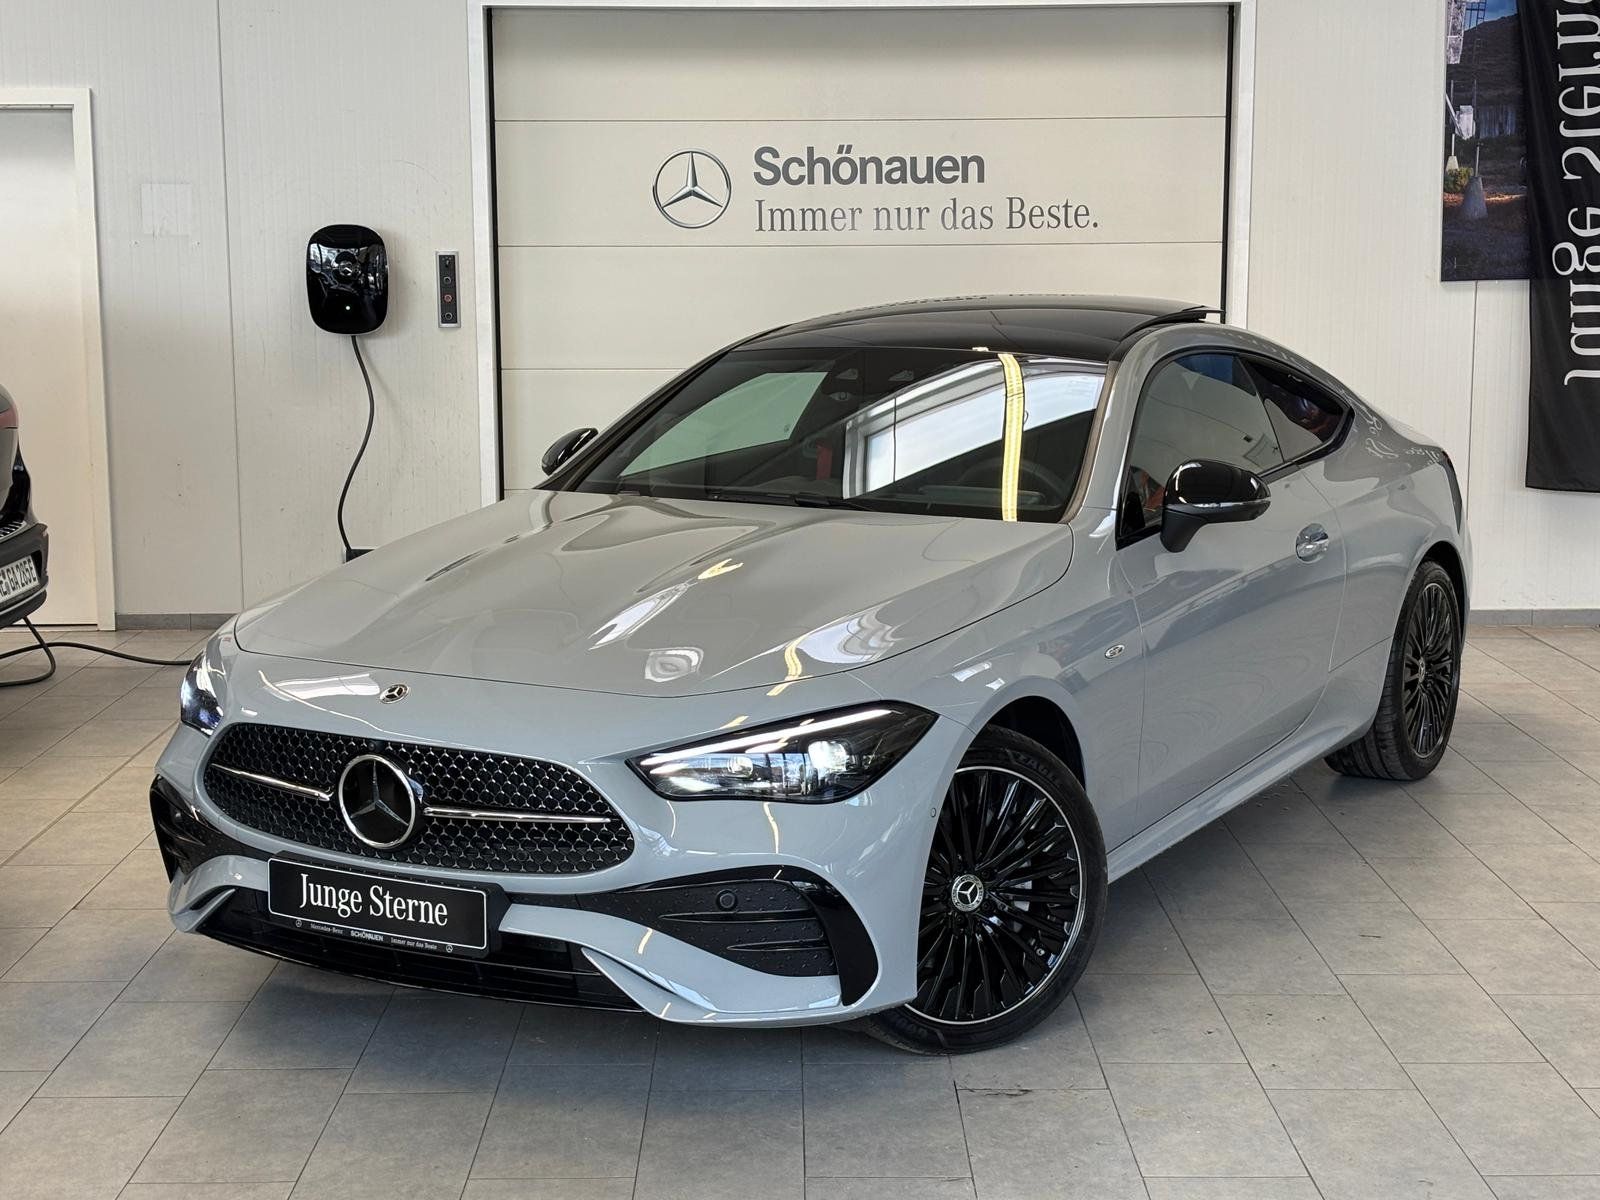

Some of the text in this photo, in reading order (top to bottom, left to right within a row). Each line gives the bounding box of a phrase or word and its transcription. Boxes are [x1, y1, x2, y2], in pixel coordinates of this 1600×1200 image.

[753, 144, 985, 186] Schönauen
[754, 196, 1099, 232] Immer nur das Beste.
[299, 873, 448, 926] Junge Sterne
